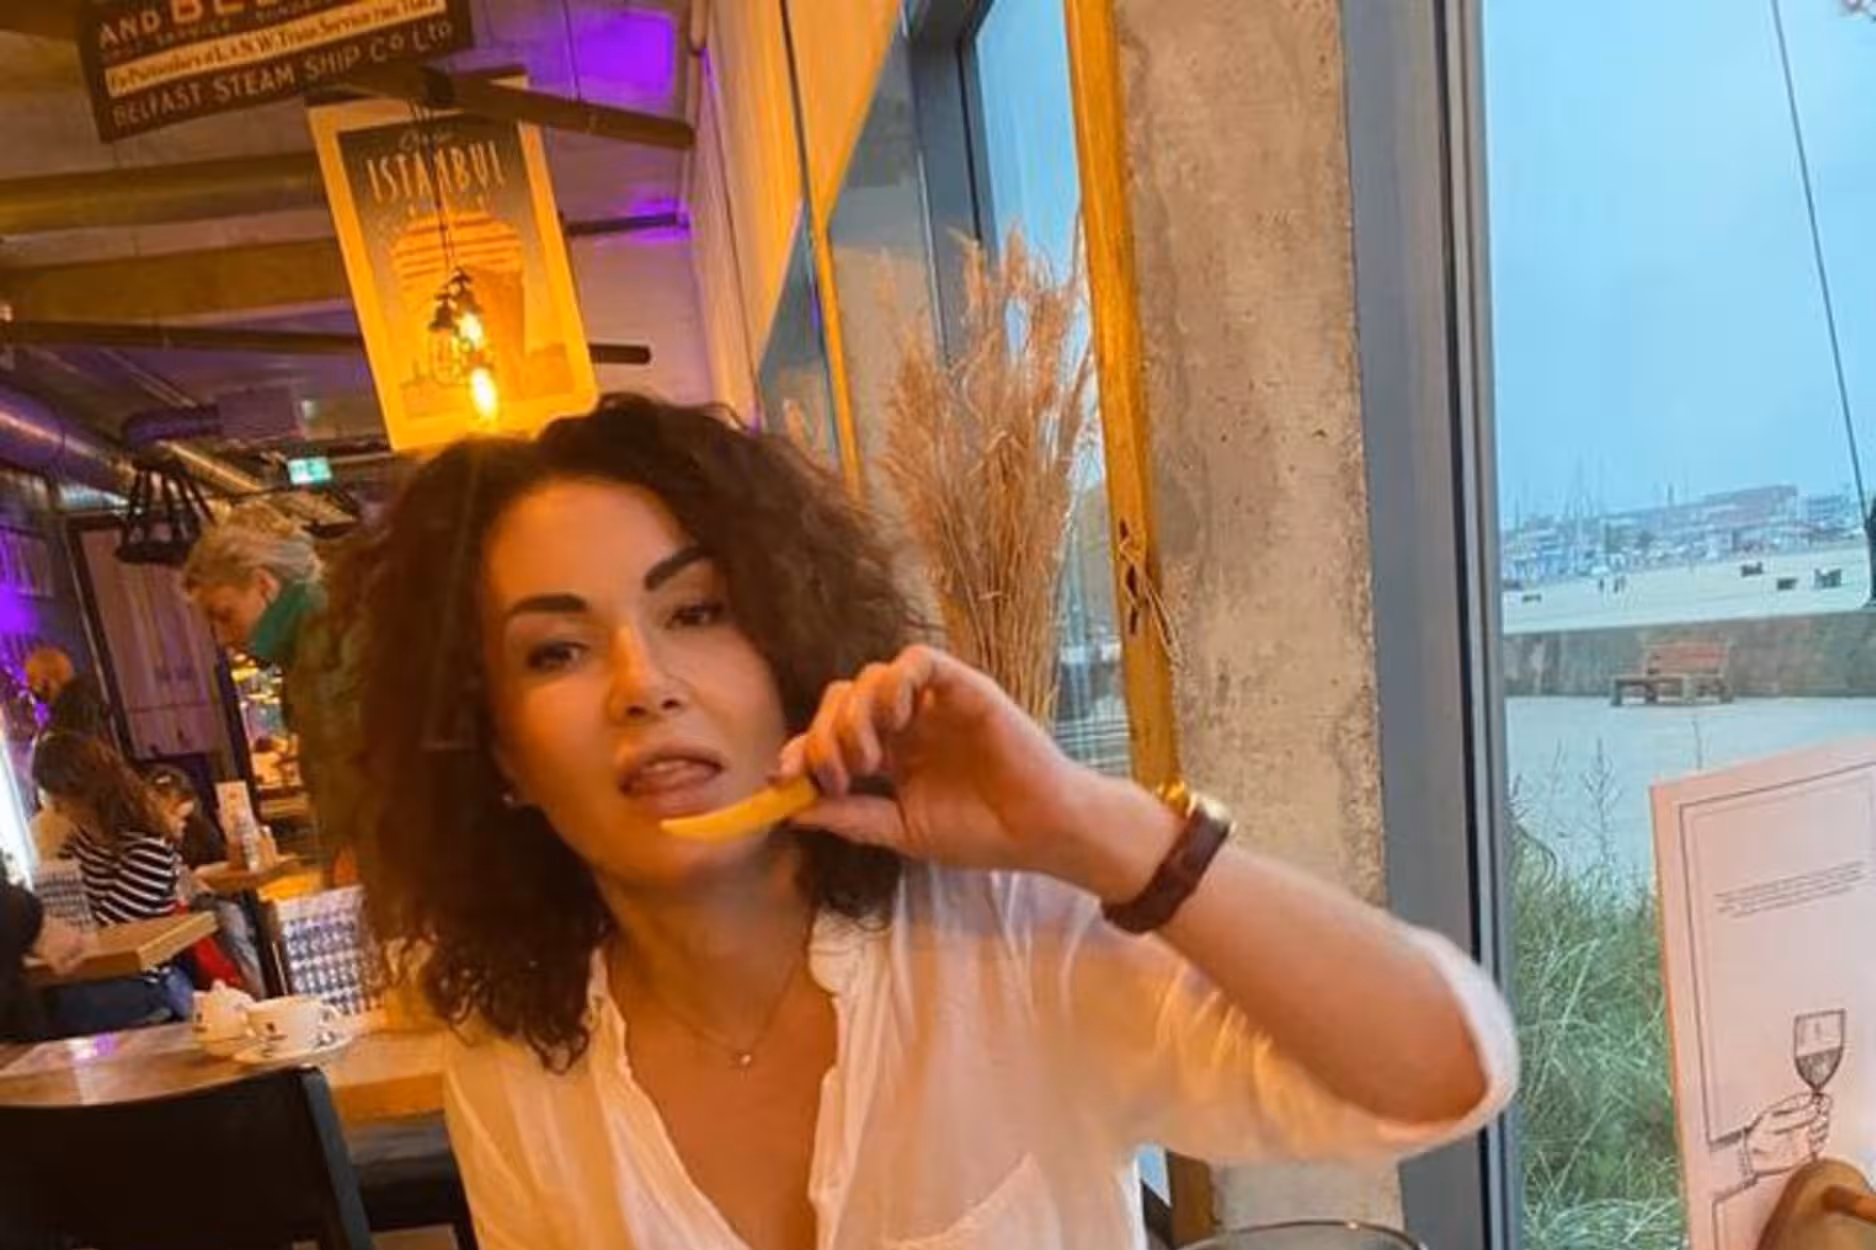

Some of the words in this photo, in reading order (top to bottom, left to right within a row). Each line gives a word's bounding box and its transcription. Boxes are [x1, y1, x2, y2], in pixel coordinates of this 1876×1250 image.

[100, 10, 161, 48] AND
[213, 61, 295, 103] STEAM
[304, 45, 361, 81] SHIP
